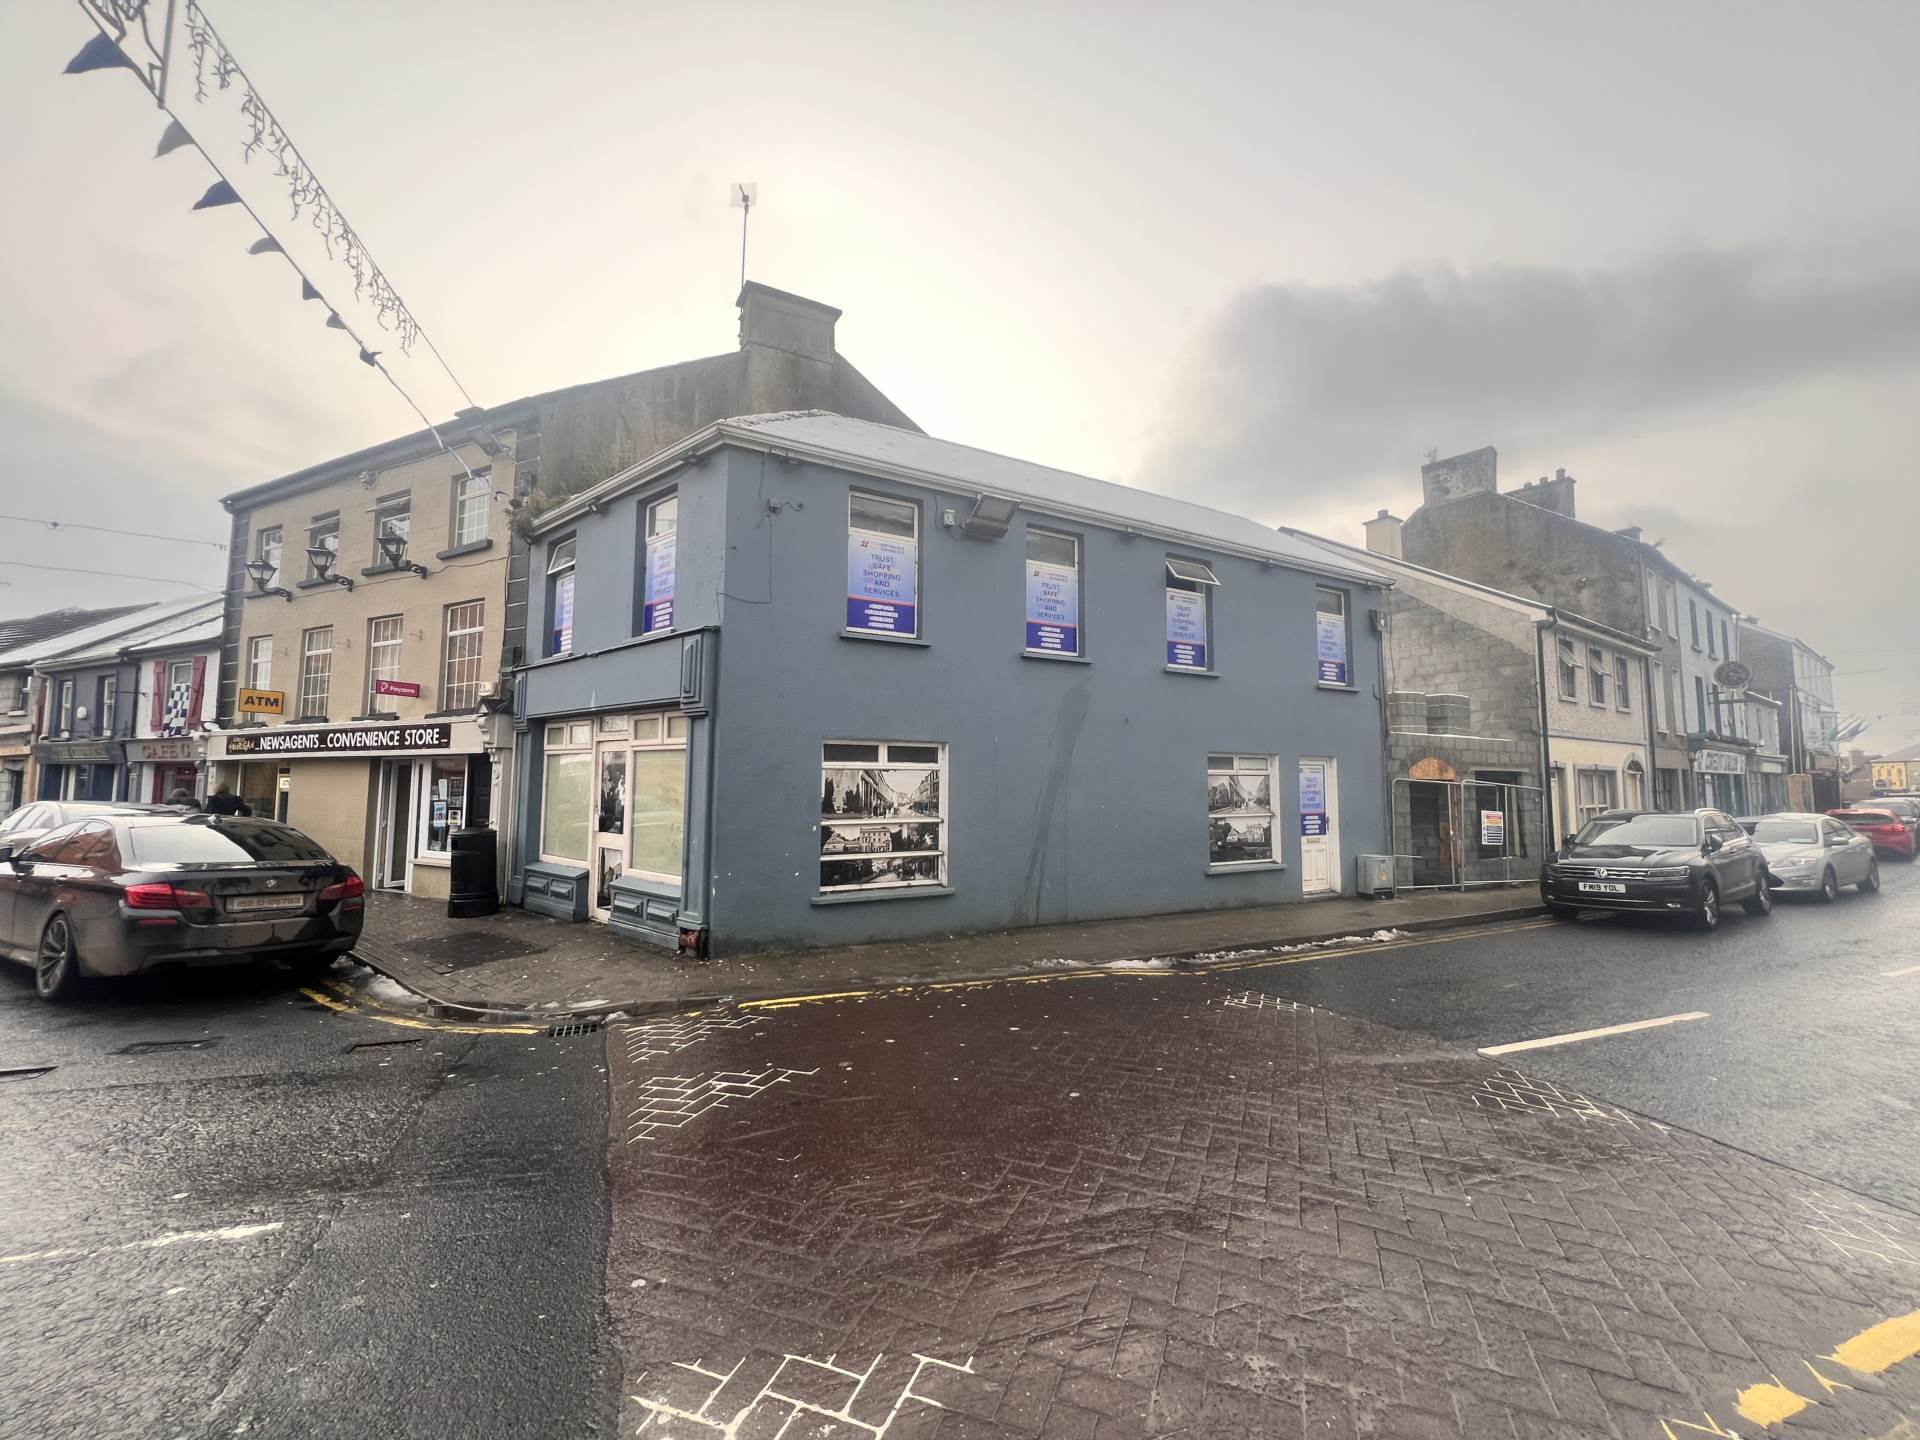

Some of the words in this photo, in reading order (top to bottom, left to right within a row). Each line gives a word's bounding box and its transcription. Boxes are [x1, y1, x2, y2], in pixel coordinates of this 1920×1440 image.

[870, 553, 894, 564] TRUST
[873, 562, 892, 571] SAFE
[863, 570, 901, 581] SHOPPING
[874, 579, 890, 588] AND
[1041, 582, 1060, 590] TRUST
[863, 586, 900, 598] SERVICES
[1035, 596, 1065, 606] SHOPPING
[244, 695, 279, 708] ATM
[259, 733, 319, 750] NEWSAGENTS
[327, 730, 400, 748] CONVENIENCE
[404, 727, 440, 746] STORE
